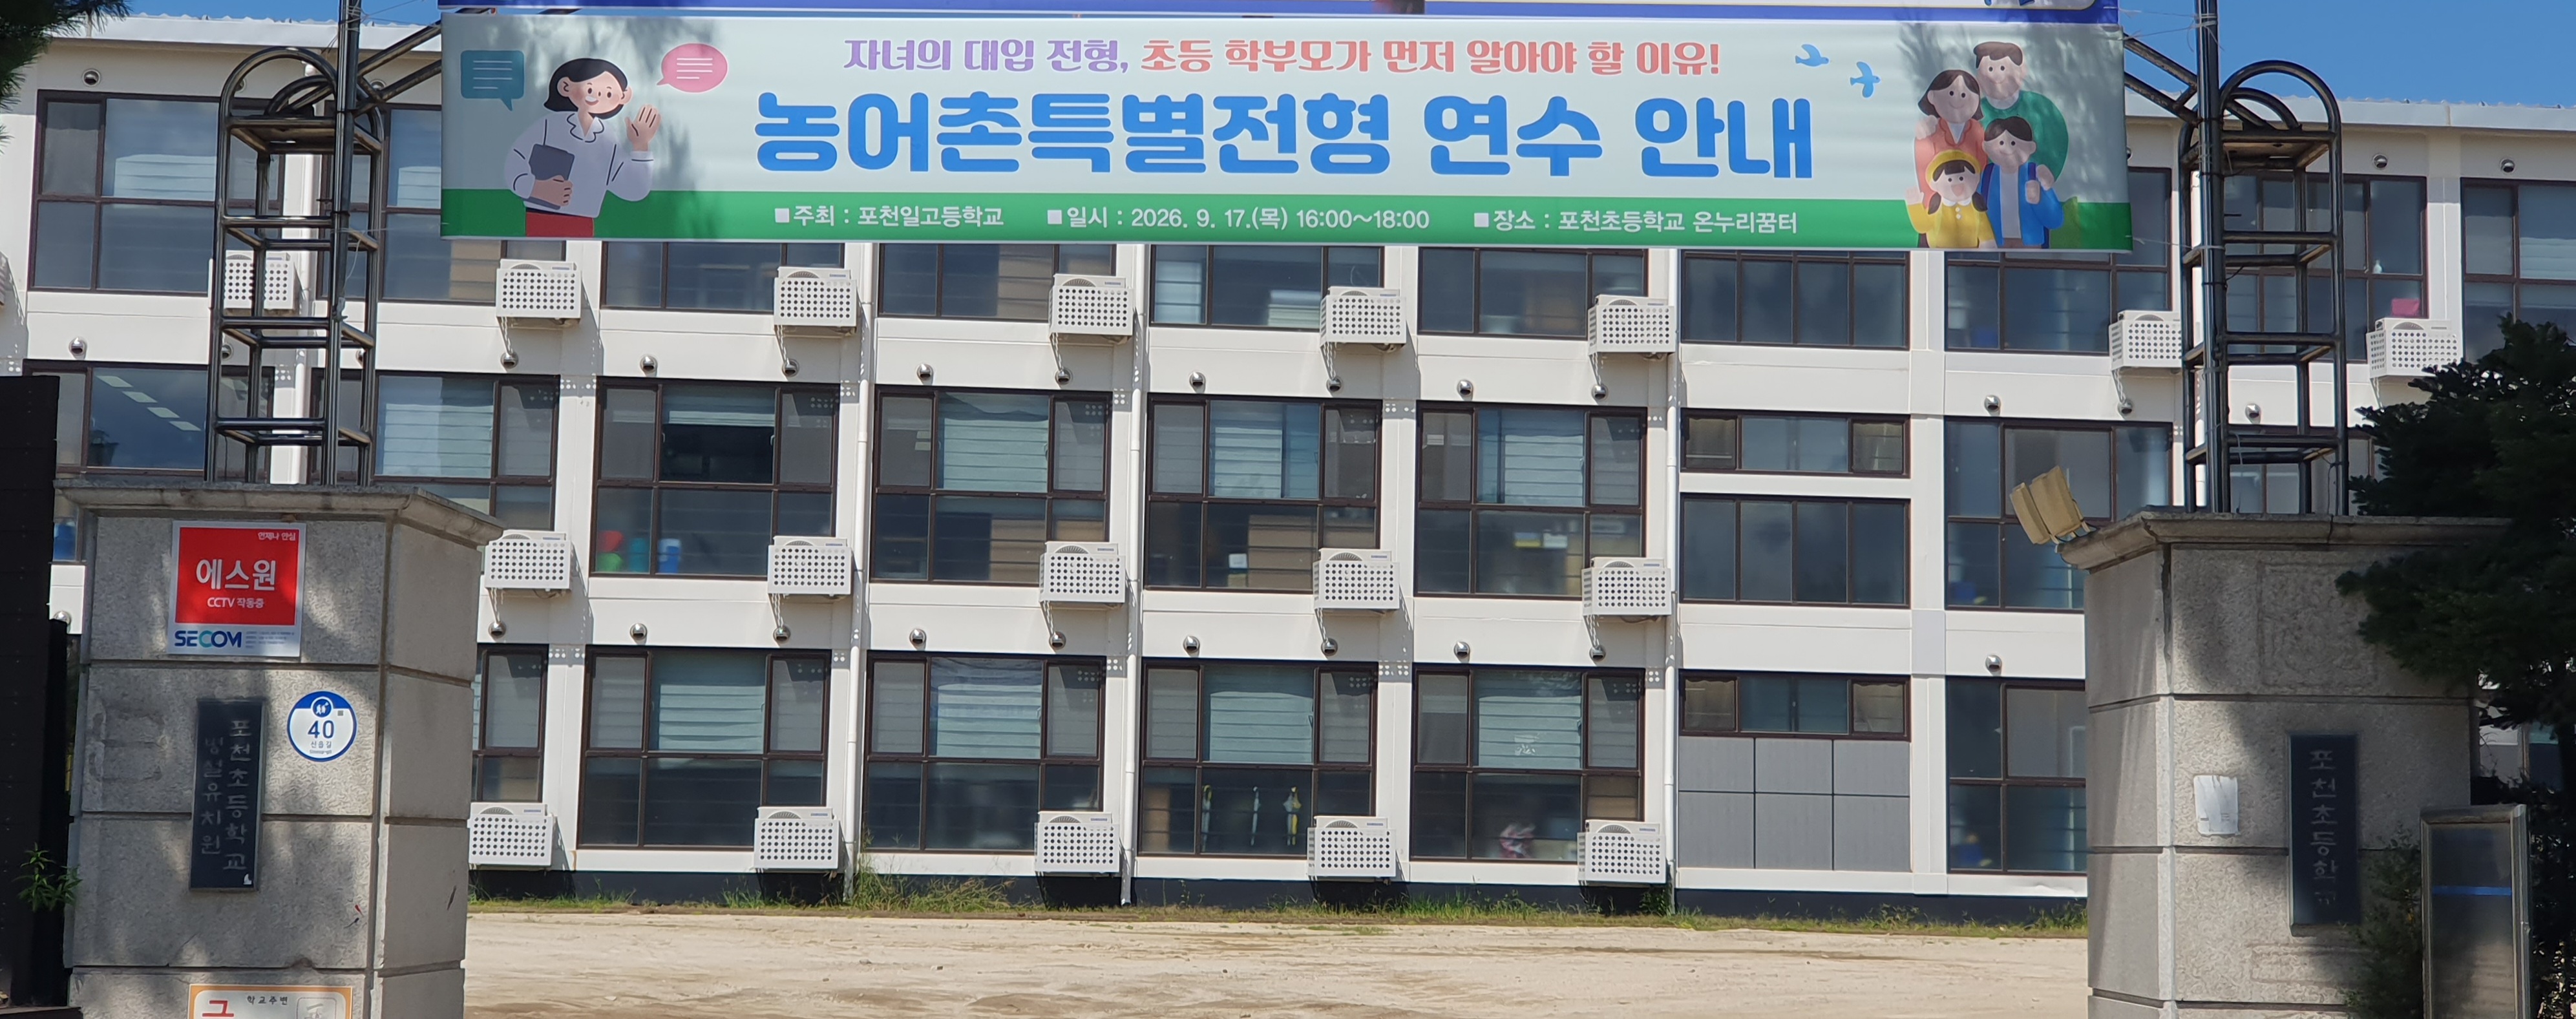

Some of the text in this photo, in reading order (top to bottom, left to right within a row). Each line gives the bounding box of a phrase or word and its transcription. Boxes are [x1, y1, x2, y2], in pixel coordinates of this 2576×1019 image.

[843, 39, 1720, 76] 자녀의 대입 전형, 초등 학부모가 먼저 알아야 할 이유!
[755, 90, 1812, 178] 농어촌특별전형 연수 안내
[793, 205, 836, 227] 주최
[857, 205, 1004, 227] 포천일고등학교
[1066, 206, 1108, 228] 일시
[1131, 209, 1188, 229] 2026.
[1196, 209, 1216, 229] 9.
[1225, 206, 1289, 231] 17.(목)
[1296, 209, 1430, 229] 16:00~18:00
[1493, 209, 1536, 232] 장소
[1558, 210, 1685, 233] 포천초등학교
[1692, 211, 1797, 235] 온누리꿈터
[196, 559, 276, 591] 에스원
[207, 597, 265, 609] CCTV 작동중
[174, 631, 242, 648] SECOM
[308, 720, 334, 739] 40
[223, 720, 253, 870] 포천초등학교
